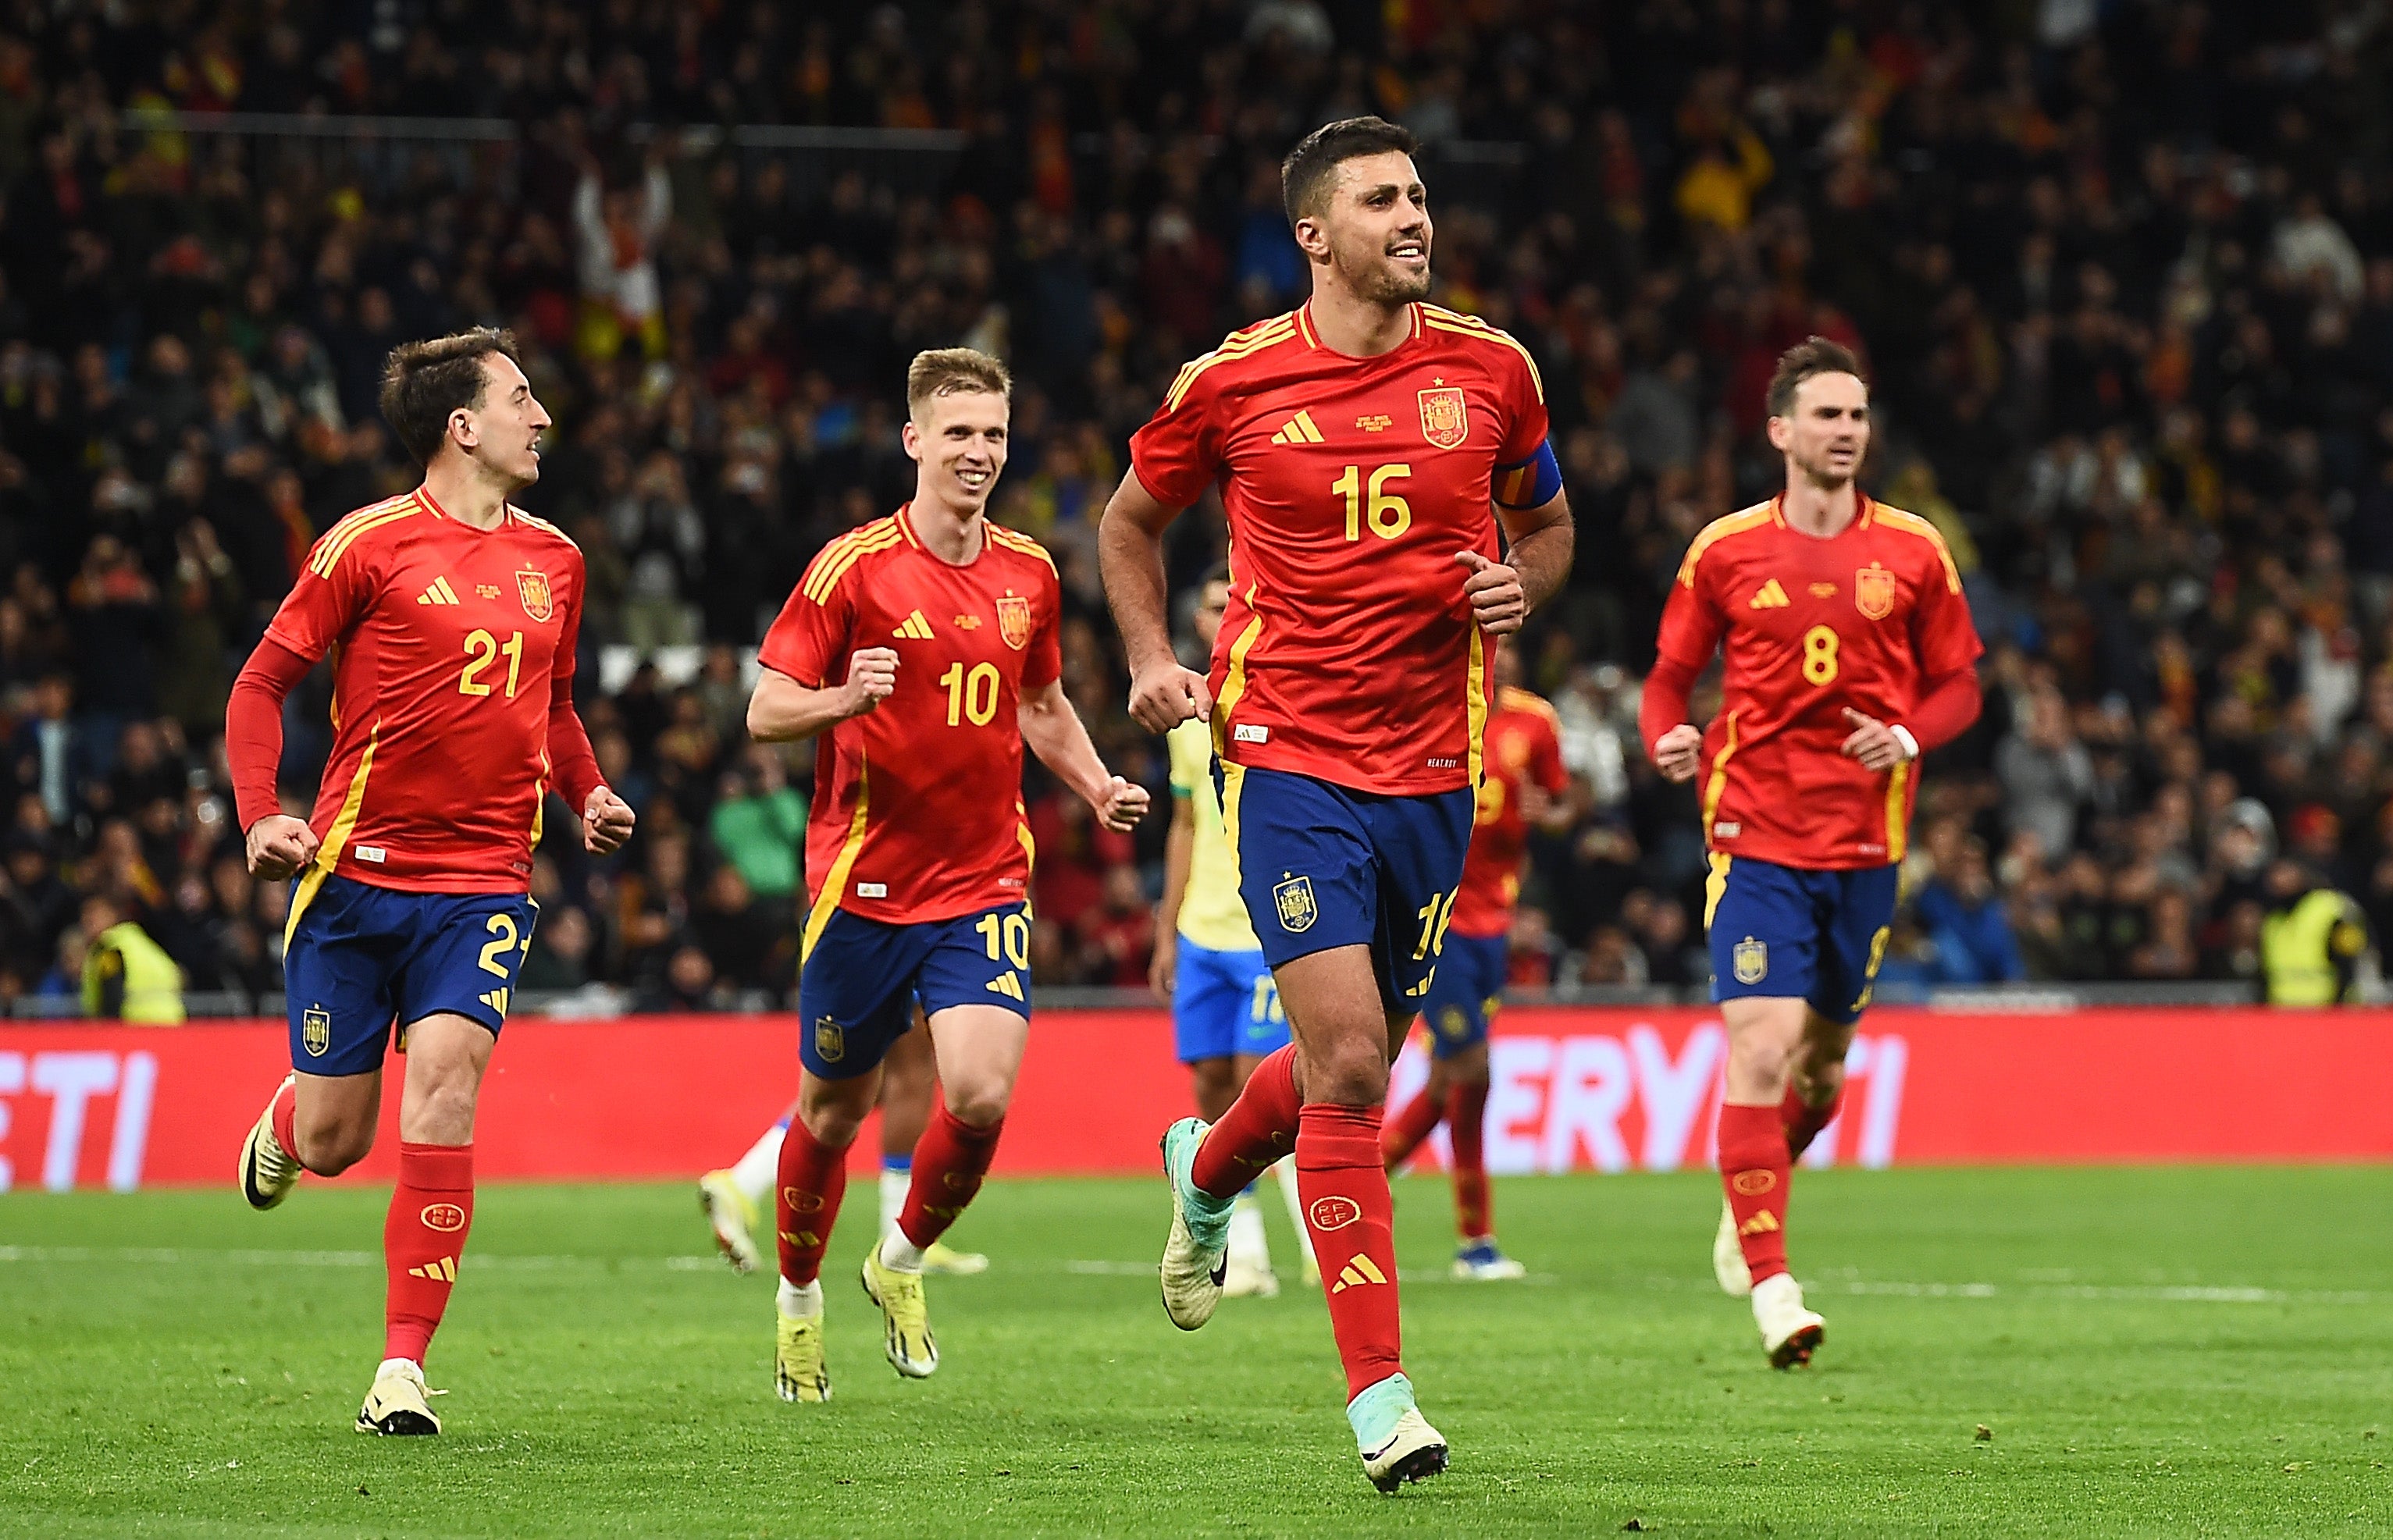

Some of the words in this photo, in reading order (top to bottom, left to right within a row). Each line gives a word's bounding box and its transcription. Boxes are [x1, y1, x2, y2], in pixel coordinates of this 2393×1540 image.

[1332, 464, 1412, 542] 16
[458, 628, 525, 698] 21
[1801, 624, 1840, 687] 8
[939, 661, 1001, 727] 10
[974, 912, 1031, 972] 10
